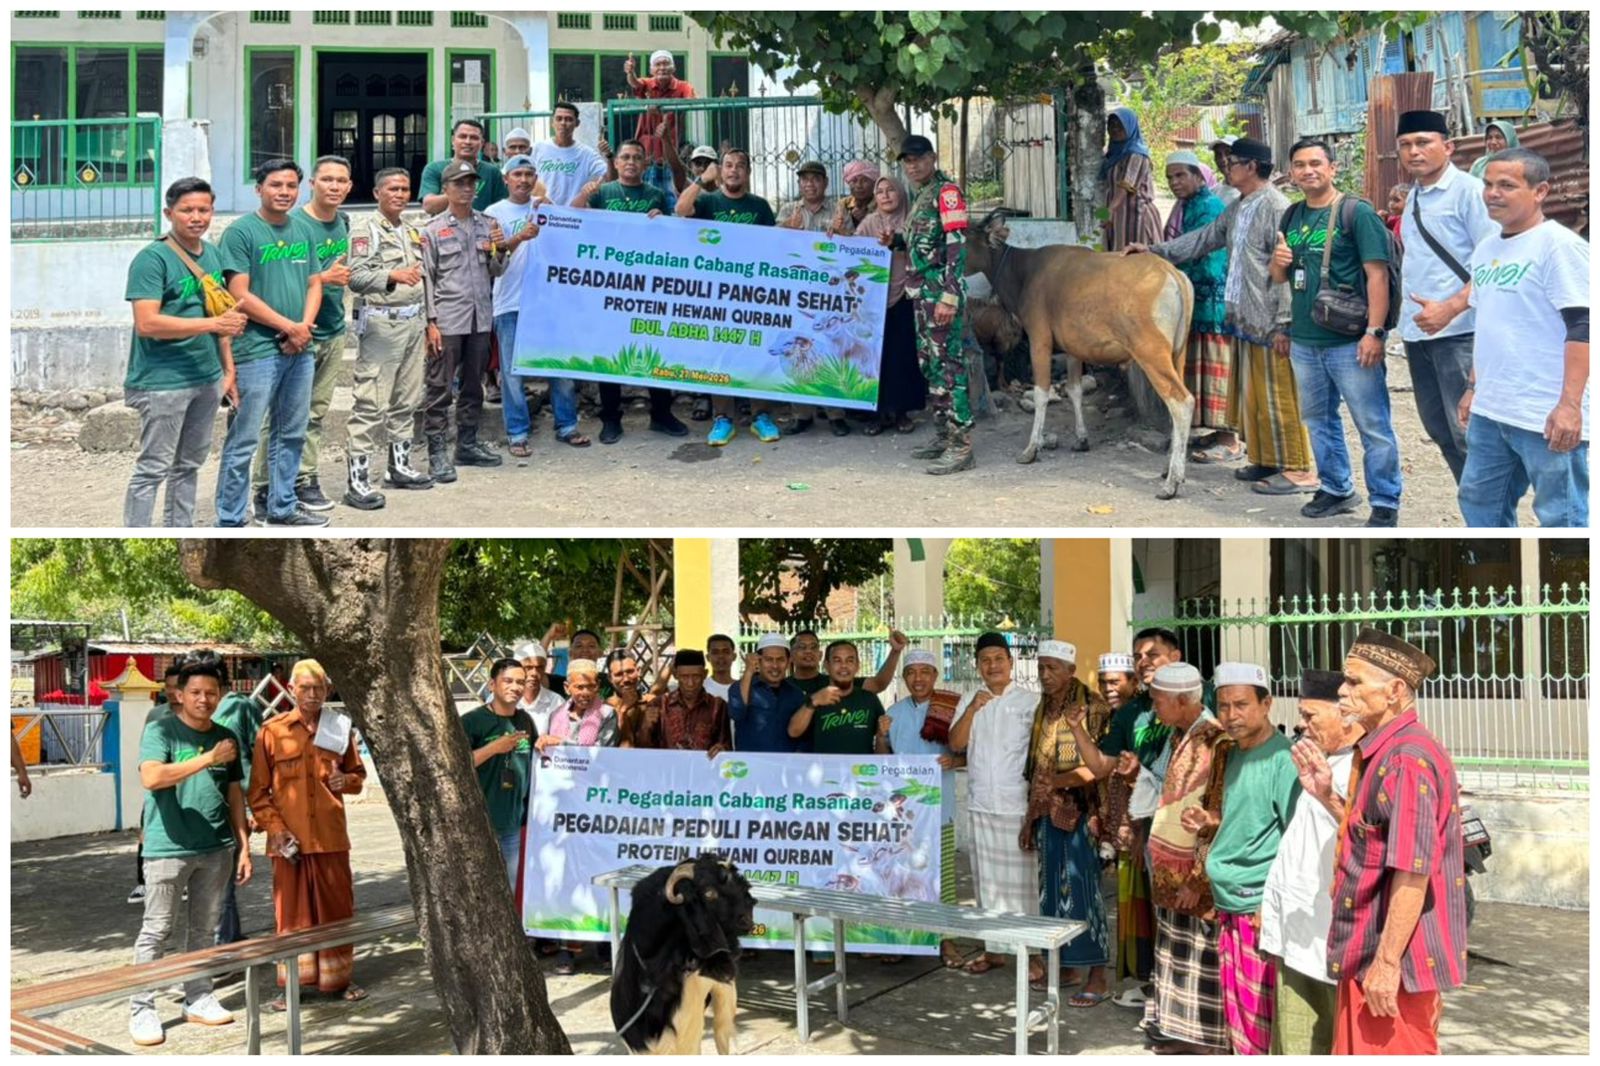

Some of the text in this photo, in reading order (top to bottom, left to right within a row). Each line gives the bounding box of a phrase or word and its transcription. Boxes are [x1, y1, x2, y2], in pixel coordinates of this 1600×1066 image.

[548, 214, 583, 224] Danantara
[548, 221, 580, 230] Indonesia
[839, 244, 886, 257] Pegadaian
[576, 243, 830, 284] PT. Pegadaian Cabang Rasanae
[546, 265, 856, 314] PEGADAIAN PEDULI PANGAN SEHAT
[604, 296, 793, 329] PROTEIN HEWANI QURBAN
[630, 317, 762, 346] IDUL ADHA 1447 H
[554, 756, 590, 765] Danantara
[554, 763, 588, 772] Indonesia
[881, 765, 935, 777] Pegadaian
[586, 787, 873, 813] PT. Pegadaian Cabang Rasanae
[553, 813, 904, 844] PEGADAIAN PEDULI PANGAN SEHAT
[617, 844, 690, 861] PROTEIN
[763, 848, 833, 866] QURBAN
[785, 870, 799, 886] H
